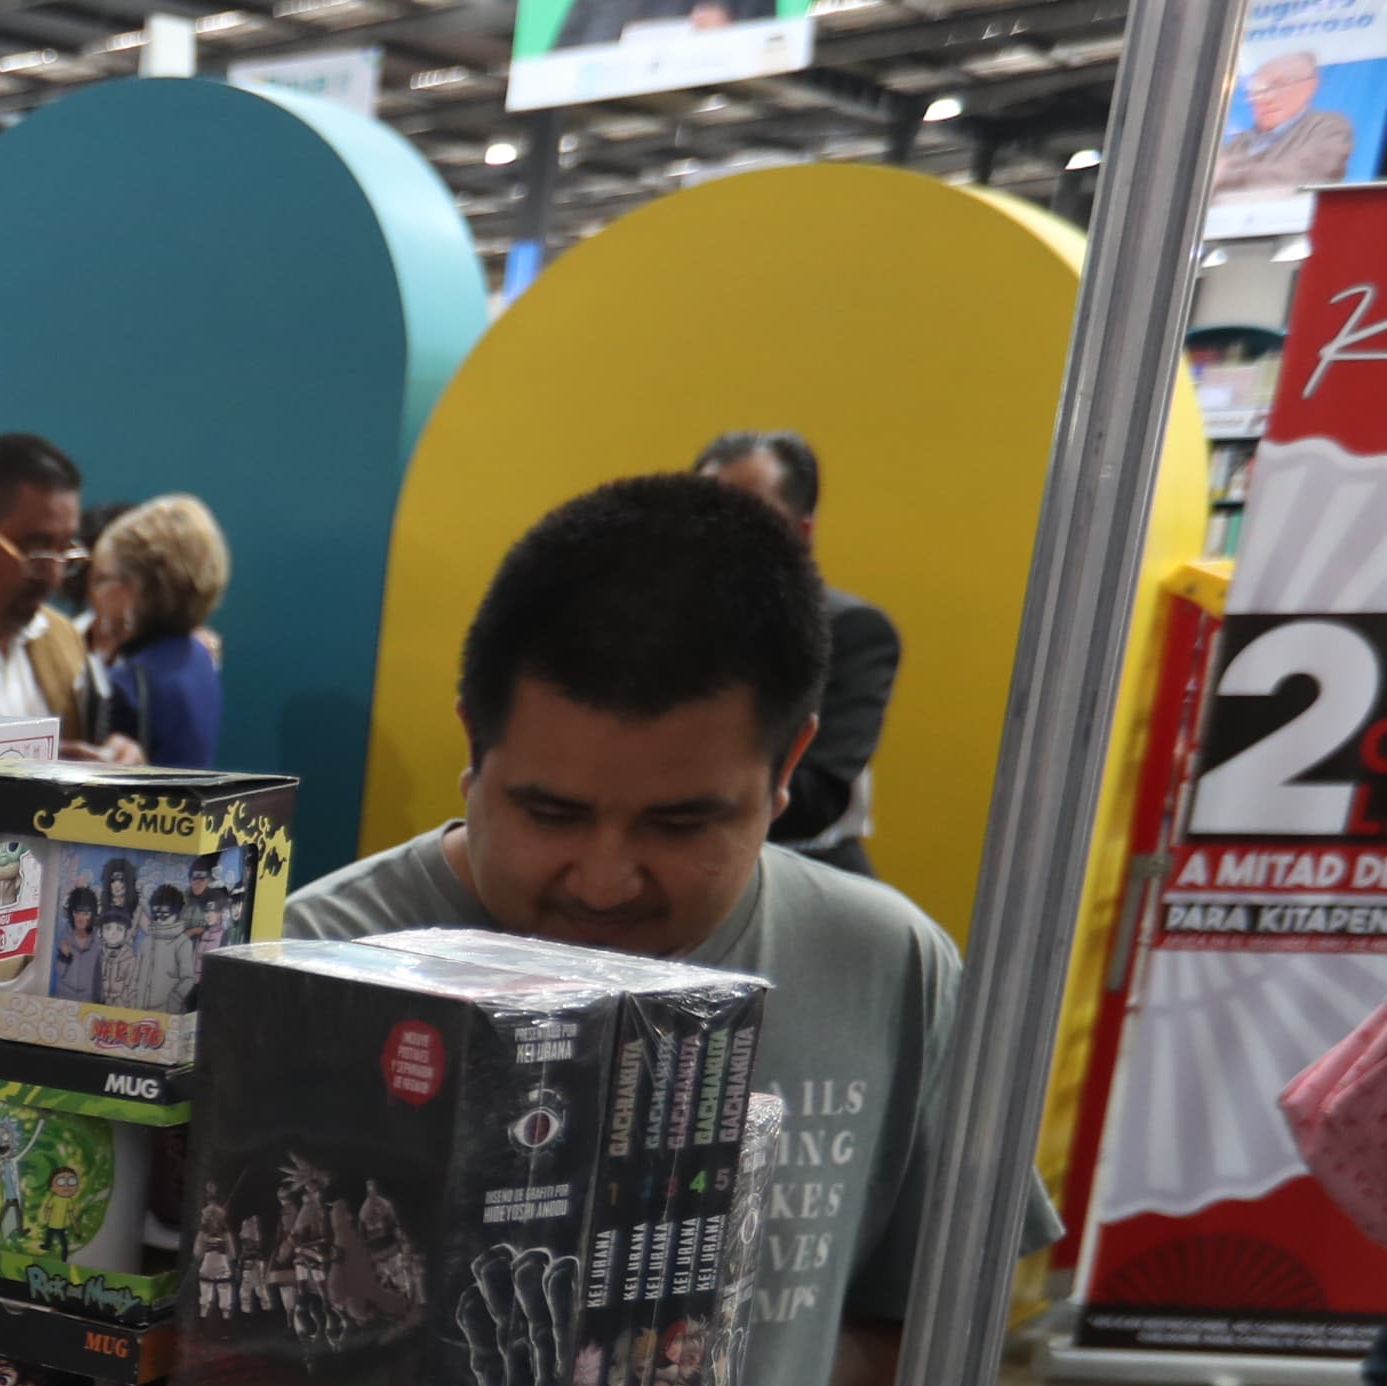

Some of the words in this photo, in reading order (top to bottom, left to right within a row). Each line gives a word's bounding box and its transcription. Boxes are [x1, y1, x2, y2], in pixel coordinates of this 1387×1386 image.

[1189, 621, 1380, 835] 2
[136, 812, 195, 836] MUG
[1177, 851, 1207, 886] A
[1215, 852, 1346, 888] MITAD
[1165, 906, 1248, 932] PARA
[90, 1019, 166, 1050] NARUTO
[104, 1073, 160, 1098] MUG
[689, 1171, 707, 1193] 4
[84, 1332, 128, 1358] MUG
